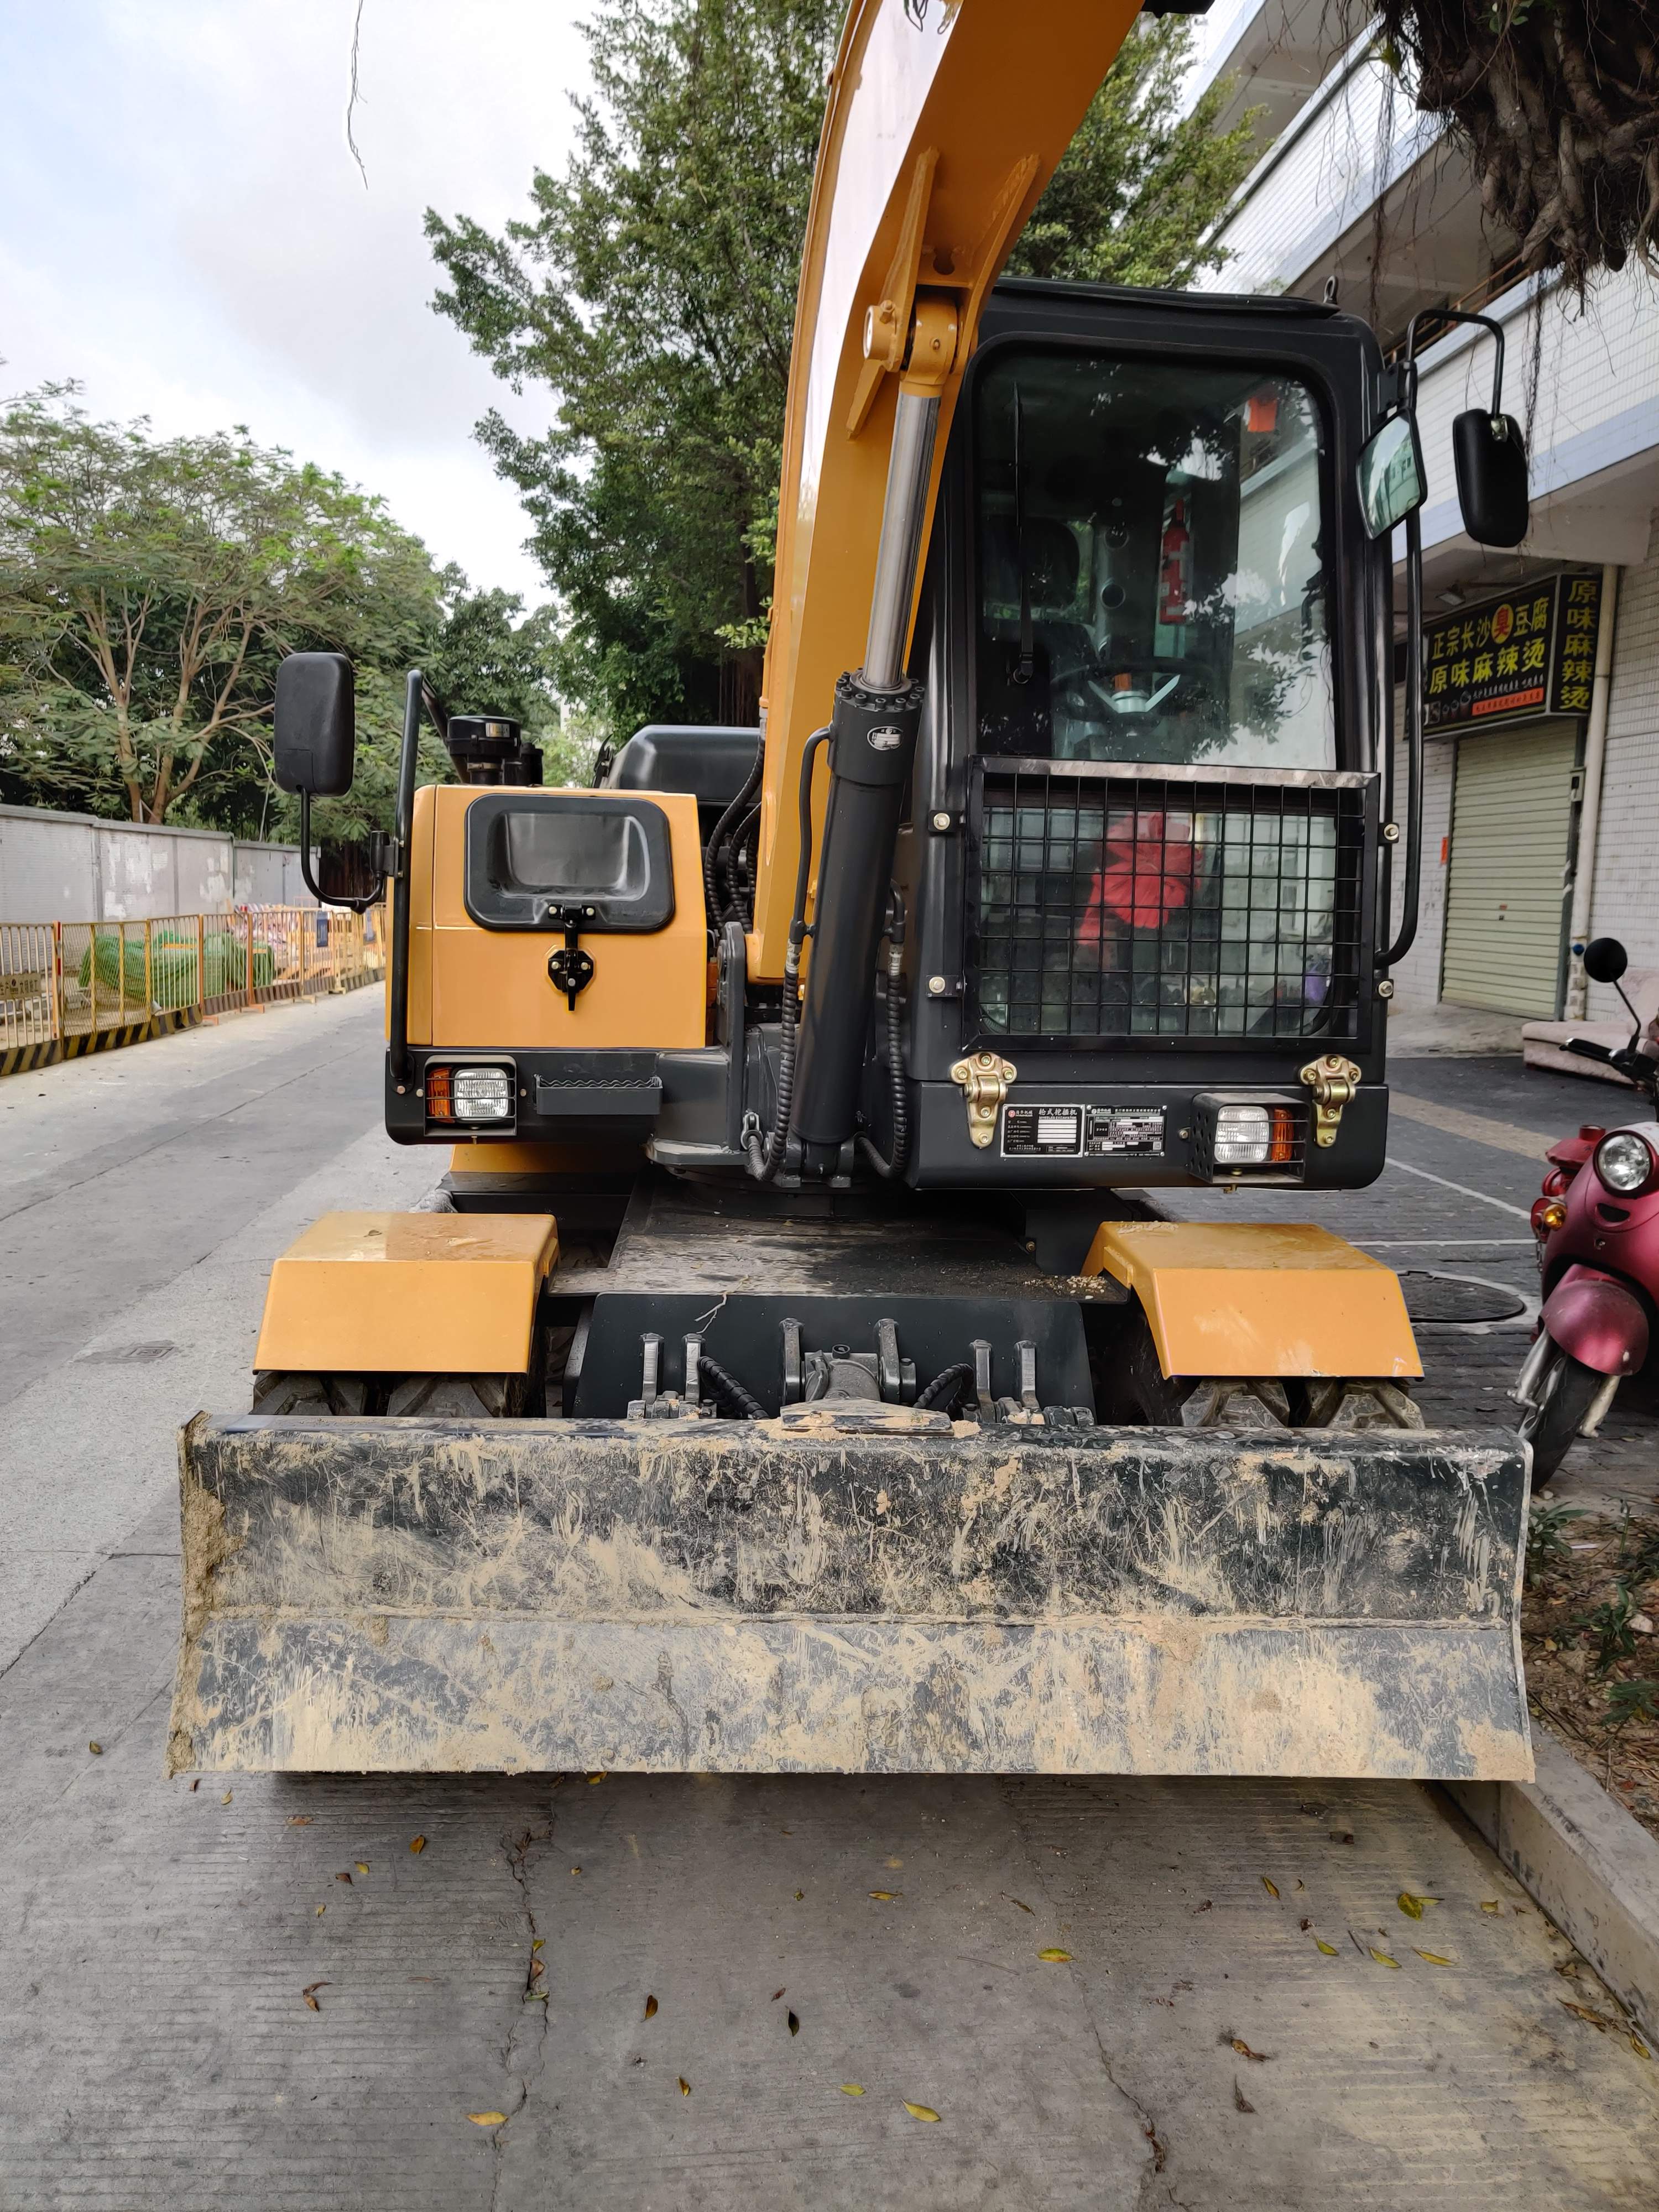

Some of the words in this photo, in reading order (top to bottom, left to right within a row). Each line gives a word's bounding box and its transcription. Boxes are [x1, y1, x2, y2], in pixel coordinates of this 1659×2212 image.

[1431, 596, 1550, 661] 正宗长沙臭豆腐
[1559, 581, 1598, 710] 原味麻辣烫
[1429, 637, 1545, 695] 原味麻辣烫
